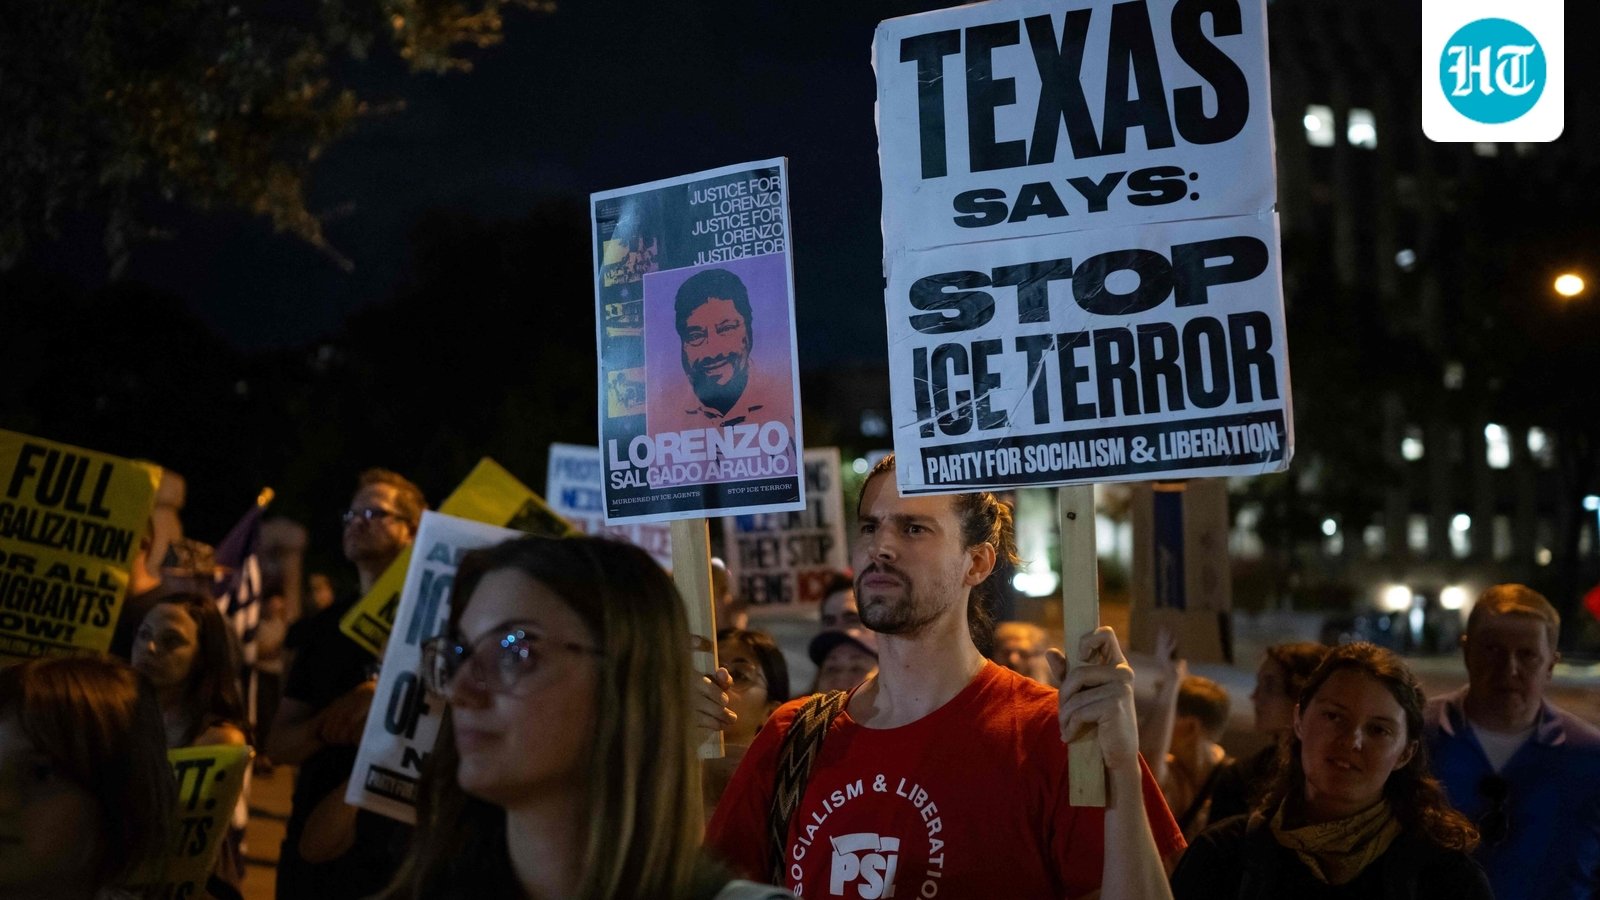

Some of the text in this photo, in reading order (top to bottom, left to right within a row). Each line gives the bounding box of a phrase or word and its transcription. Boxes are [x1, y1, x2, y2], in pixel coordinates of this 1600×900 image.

[900, 0, 1250, 180] TEXAS
[690, 176, 781, 205] JUSTICE FOR
[712, 191, 781, 216] LORENZO
[953, 165, 1200, 229] SAYS:
[692, 206, 783, 236] JUSTICE FOR
[715, 222, 784, 247] LORENZO
[694, 238, 785, 266] JUSTICE FOR
[909, 235, 1269, 335] STOP
[912, 311, 1279, 438] ICE TERROR
[608, 421, 790, 470] LORENZO
[926, 421, 1280, 484] PARTY FOR SOCIALISM & LIBERATION
[7, 444, 114, 518] FULL
[610, 455, 790, 490] SALGADO ARAUJO
[760, 483, 792, 492] TERROR!
[612, 490, 701, 505] MURDERED BY ICE AGENTS
[46, 562, 119, 592] ALL
[791, 774, 945, 900] SOCIALISM & LIBERATIO
[830, 847, 899, 900] PSL
